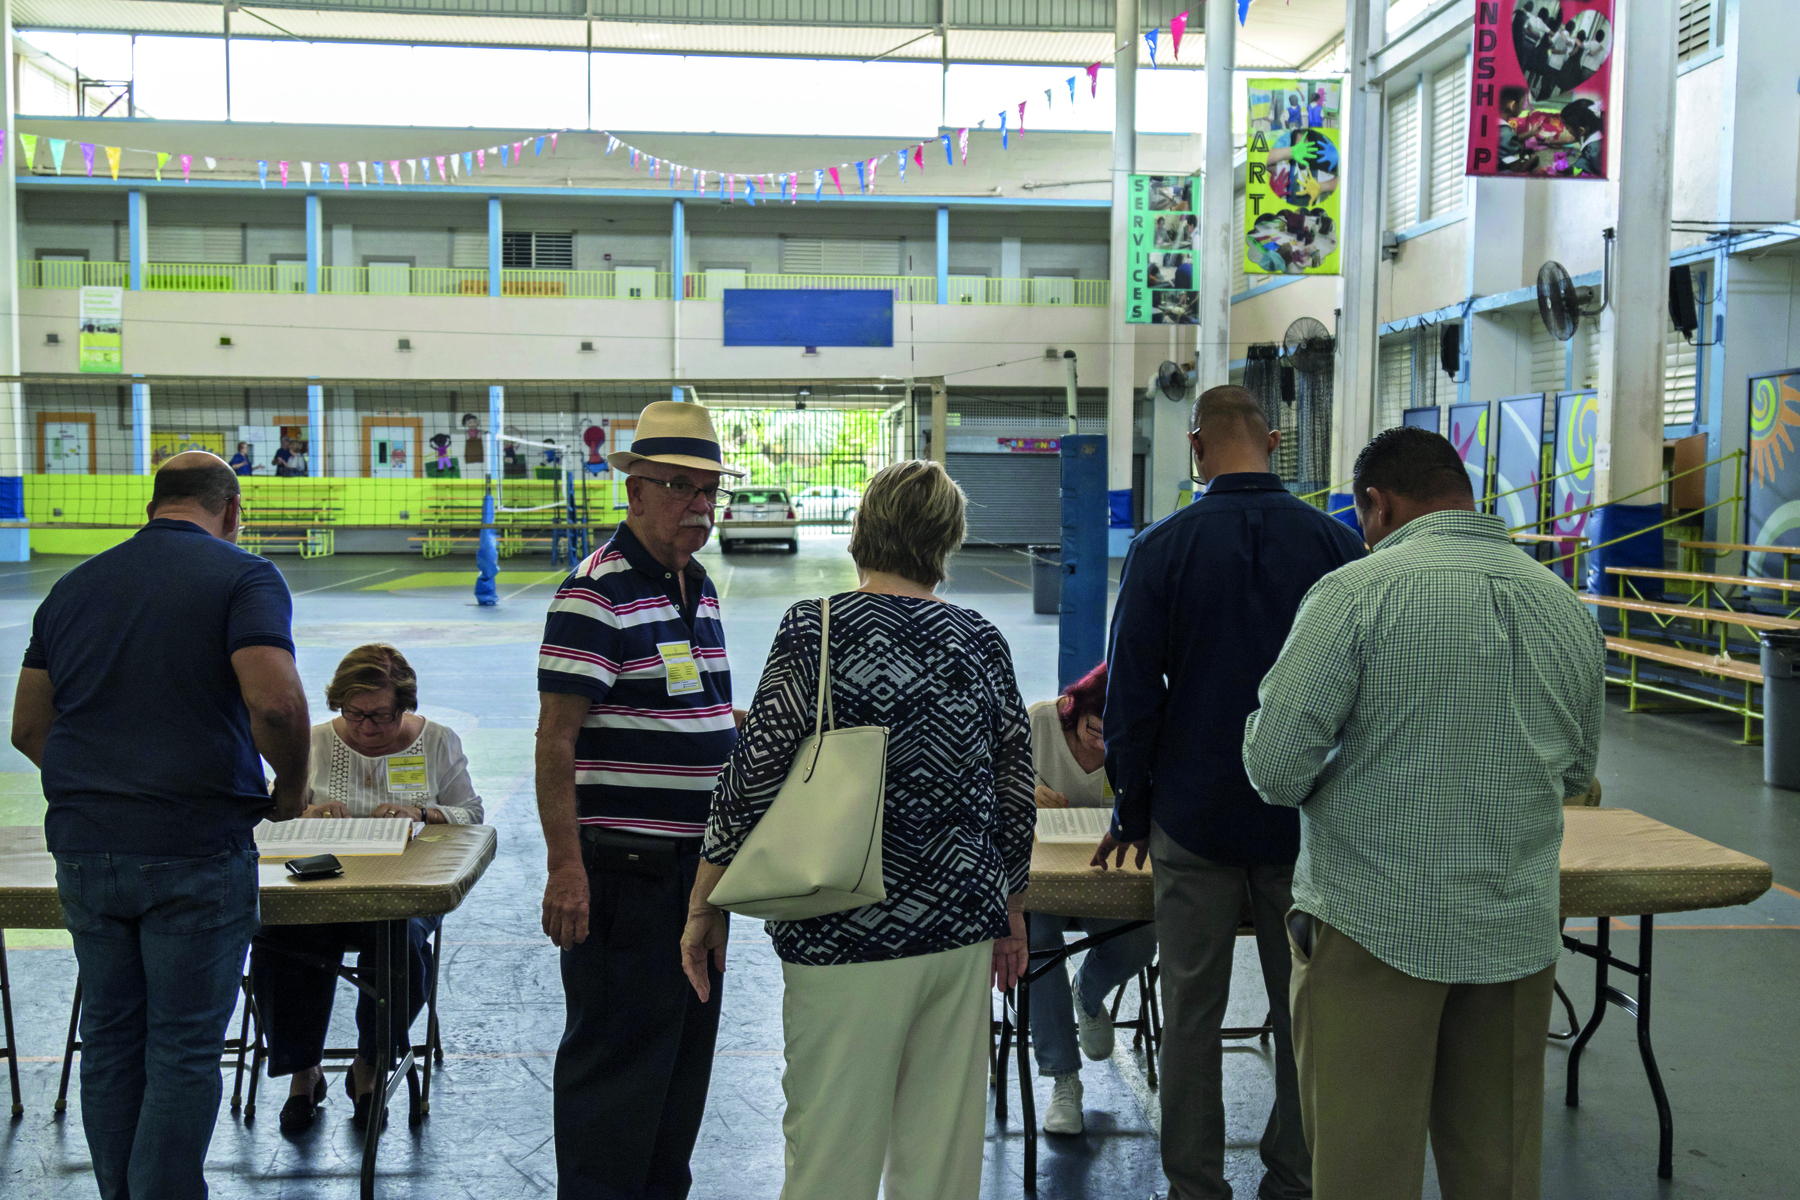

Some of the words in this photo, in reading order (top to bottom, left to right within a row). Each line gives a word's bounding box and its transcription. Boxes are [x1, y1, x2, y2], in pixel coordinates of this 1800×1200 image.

[1474, 2, 1498, 170] NDSHIP
[1249, 130, 1270, 216] ART
[1132, 179, 1144, 319] SERVICES
